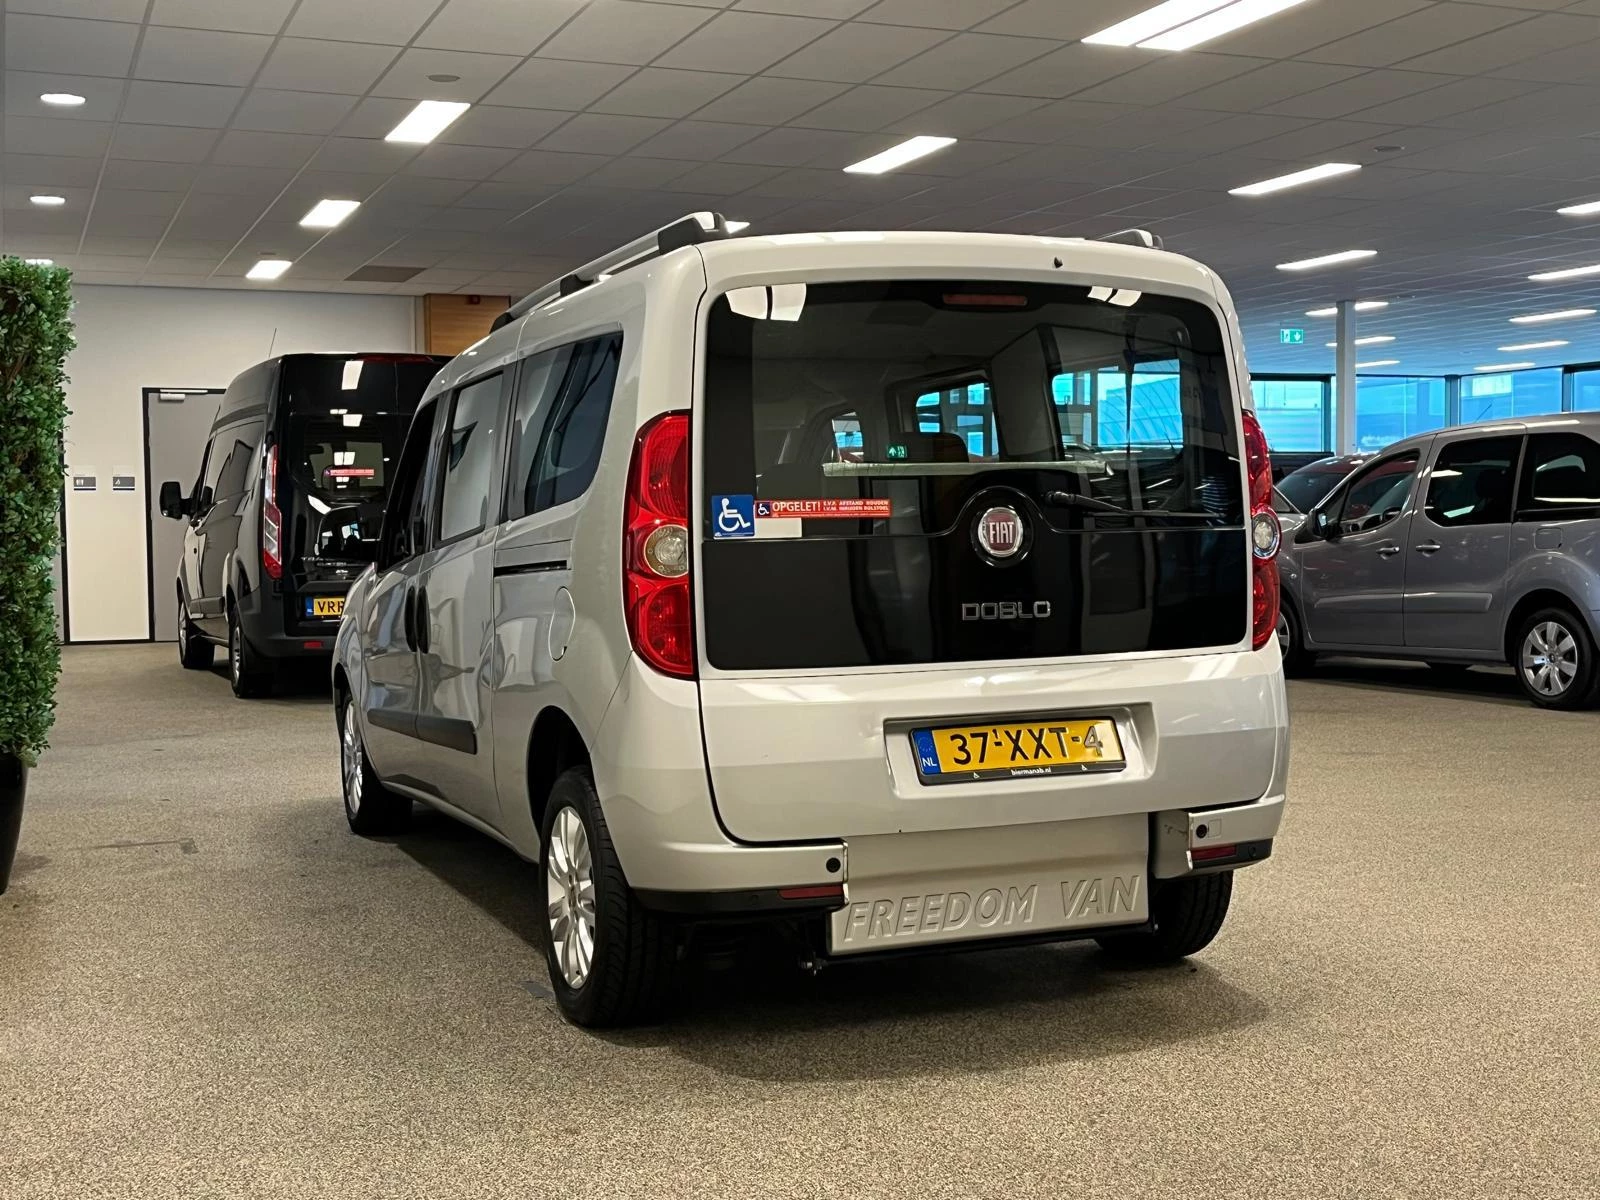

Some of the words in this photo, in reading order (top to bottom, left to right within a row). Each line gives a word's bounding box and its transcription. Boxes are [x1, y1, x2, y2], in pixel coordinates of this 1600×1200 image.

[772, 501, 821, 512] OPGELET!
[989, 521, 1015, 544] FIAT
[962, 601, 1051, 620] DOBLO
[922, 757, 937, 767] NL
[843, 884, 1039, 942] FREEDOM
[1060, 875, 1139, 919] VAN
